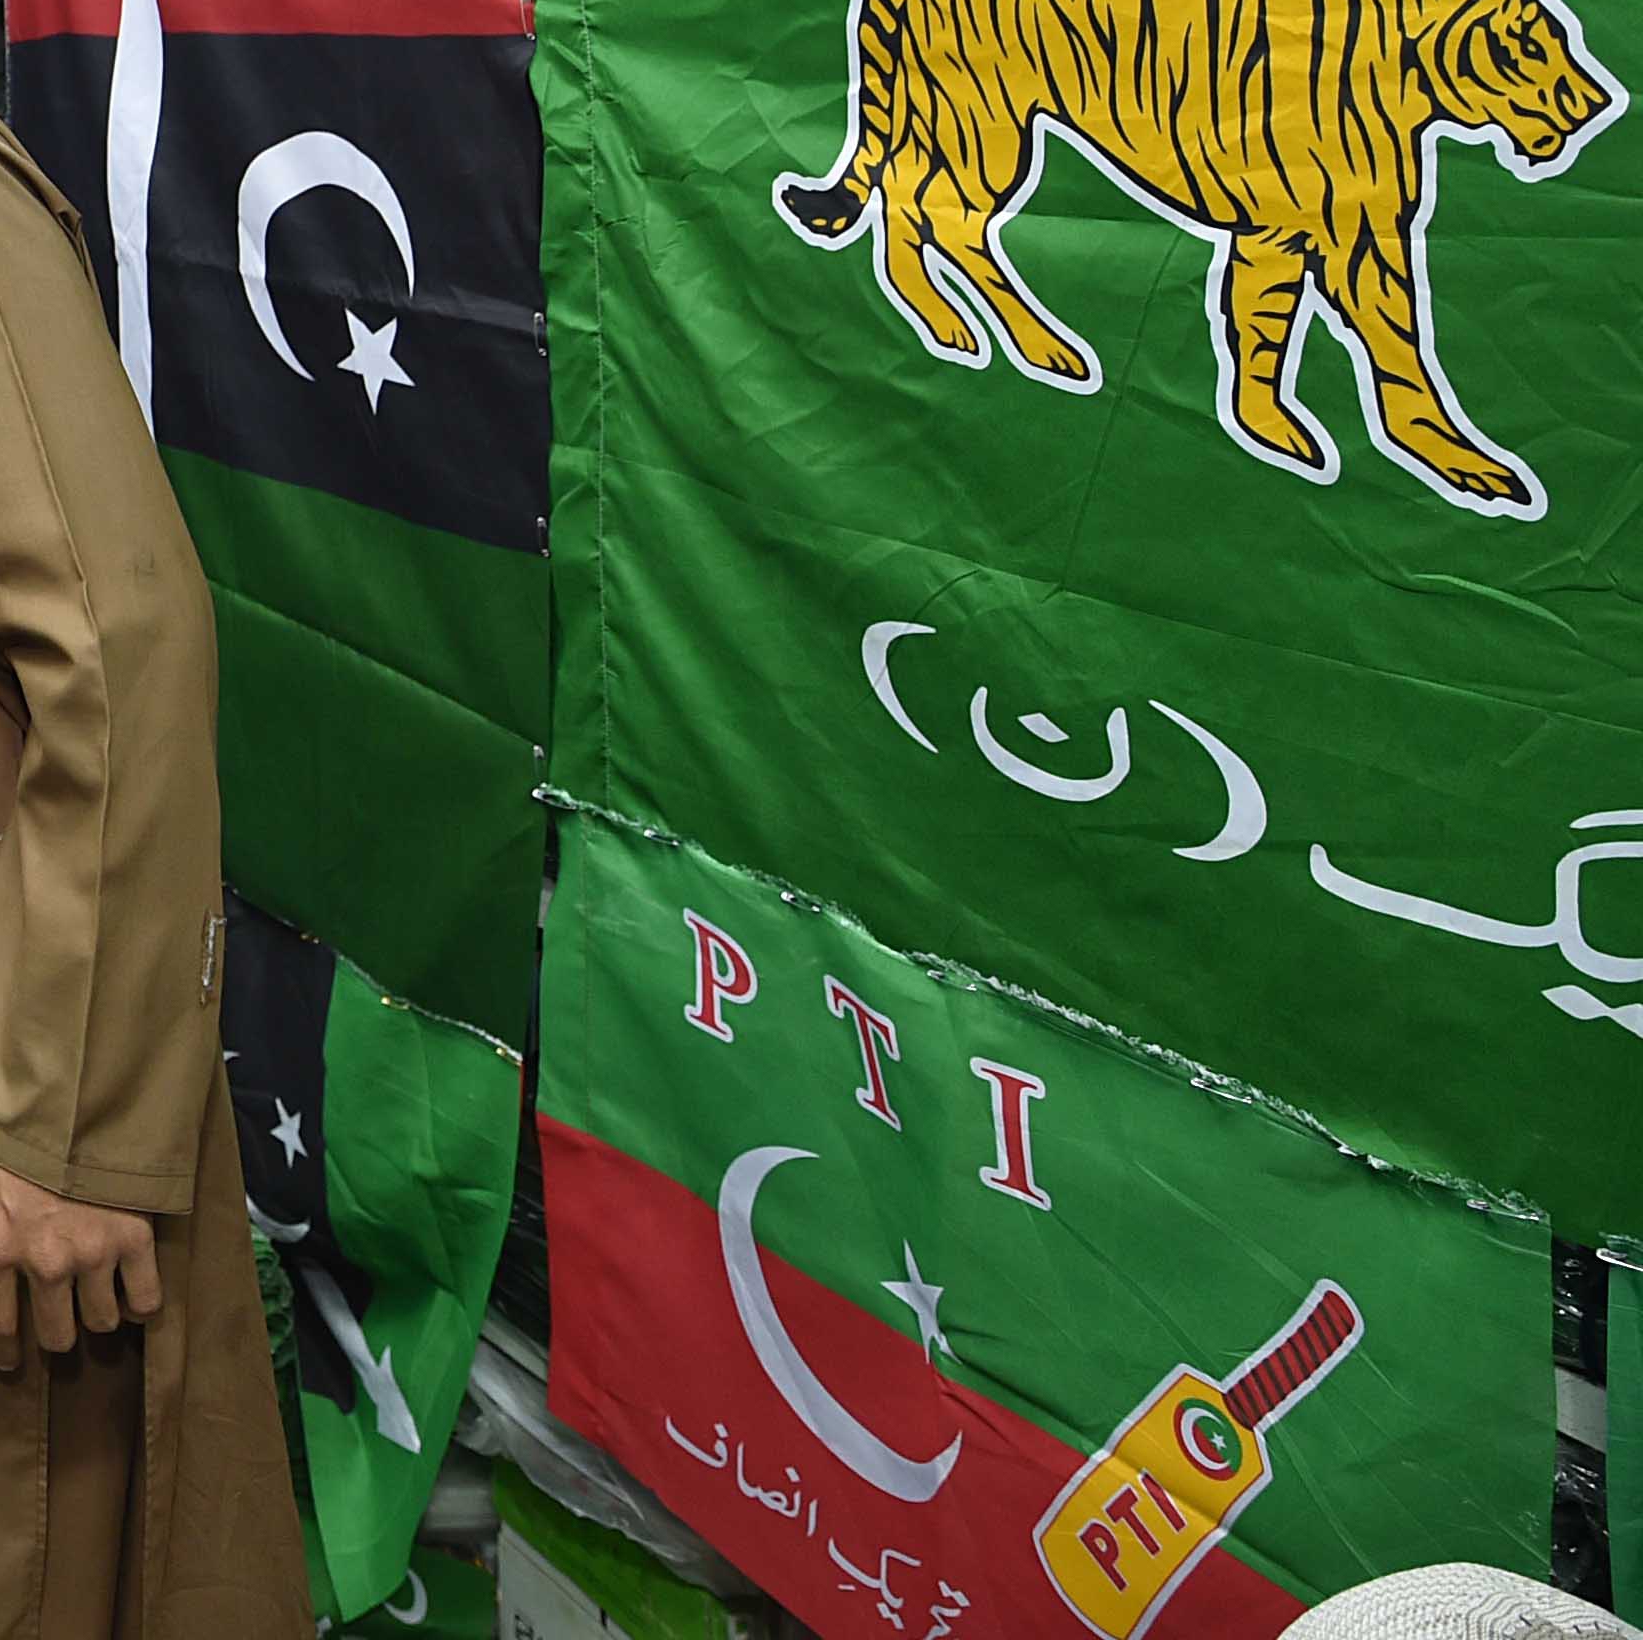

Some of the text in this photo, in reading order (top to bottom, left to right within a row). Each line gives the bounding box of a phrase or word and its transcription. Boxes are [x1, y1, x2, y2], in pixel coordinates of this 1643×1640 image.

[682, 907, 1051, 1211] PTI
[665, 1415, 818, 1538] انصاف
[1077, 1467, 1188, 1593] PTI
